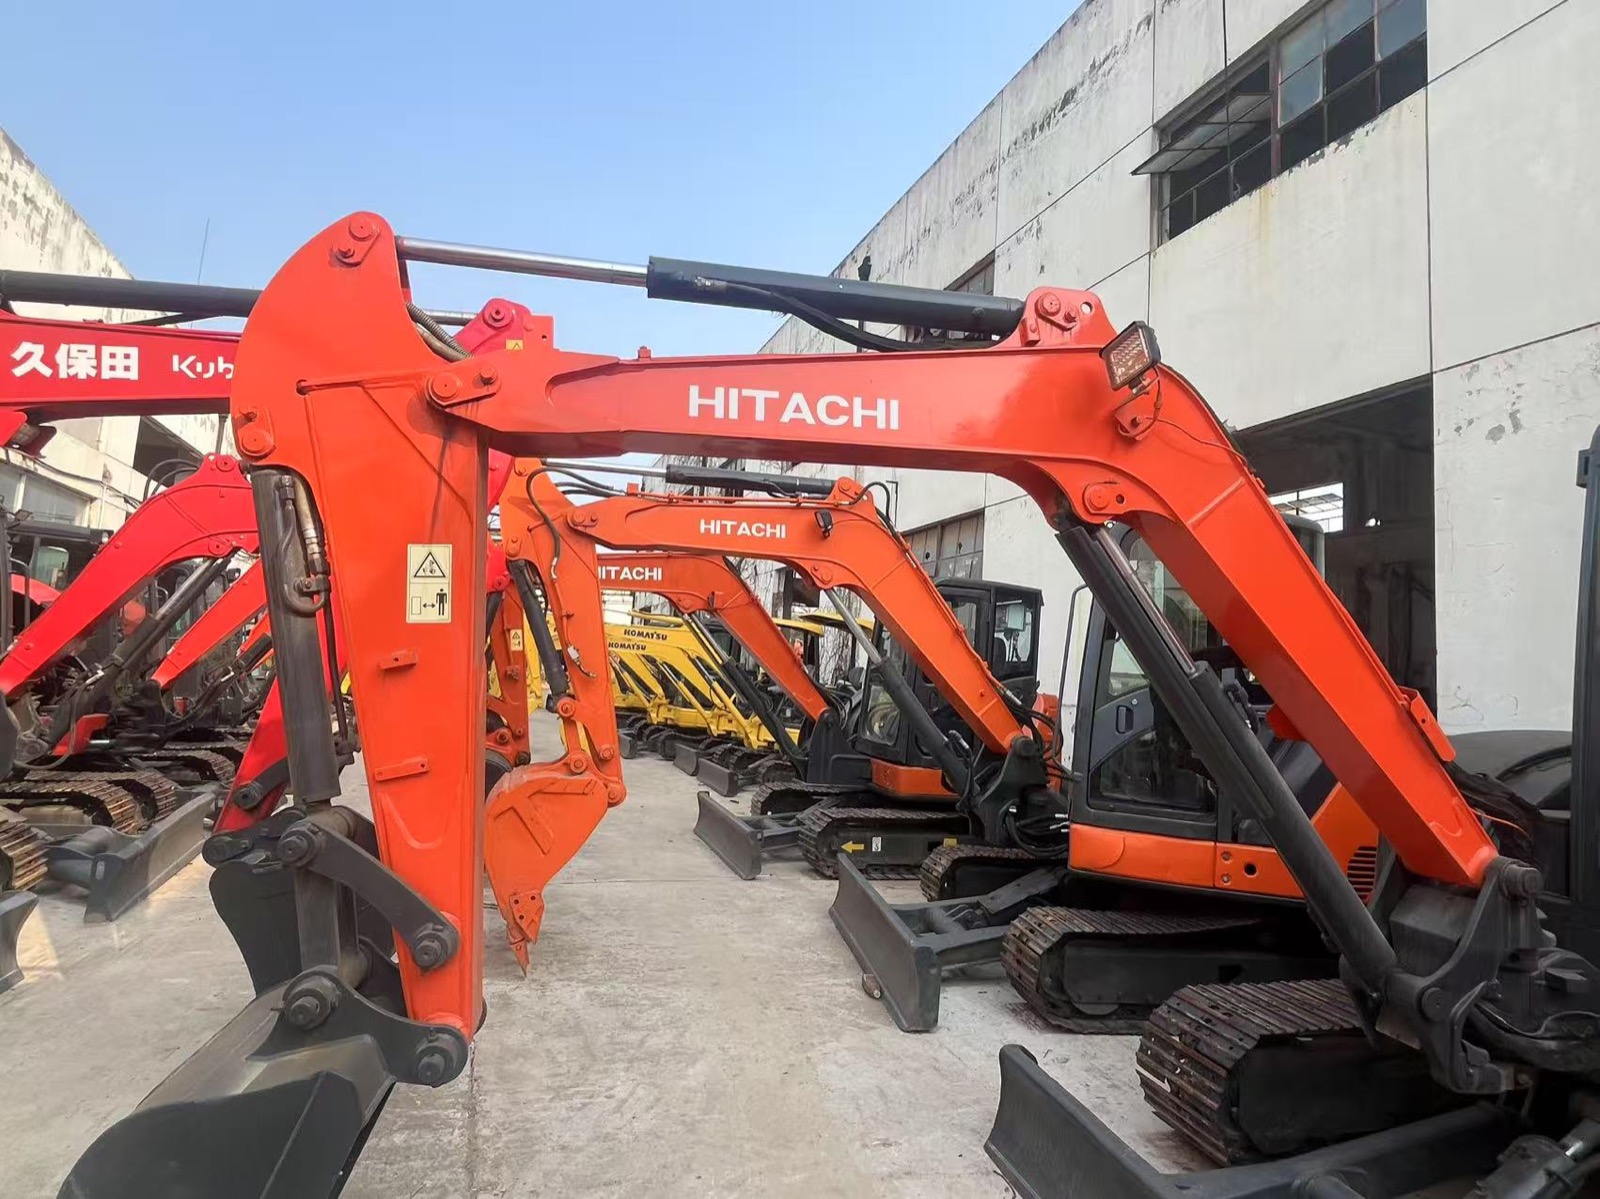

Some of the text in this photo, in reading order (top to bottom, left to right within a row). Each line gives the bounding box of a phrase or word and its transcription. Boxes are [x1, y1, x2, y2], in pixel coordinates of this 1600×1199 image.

[10, 341, 139, 380] 久保田
[688, 384, 899, 430] HITACHI
[700, 518, 787, 539] HITACHI
[623, 628, 668, 641] KOMATSU
[608, 641, 647, 651] KOMATSU
